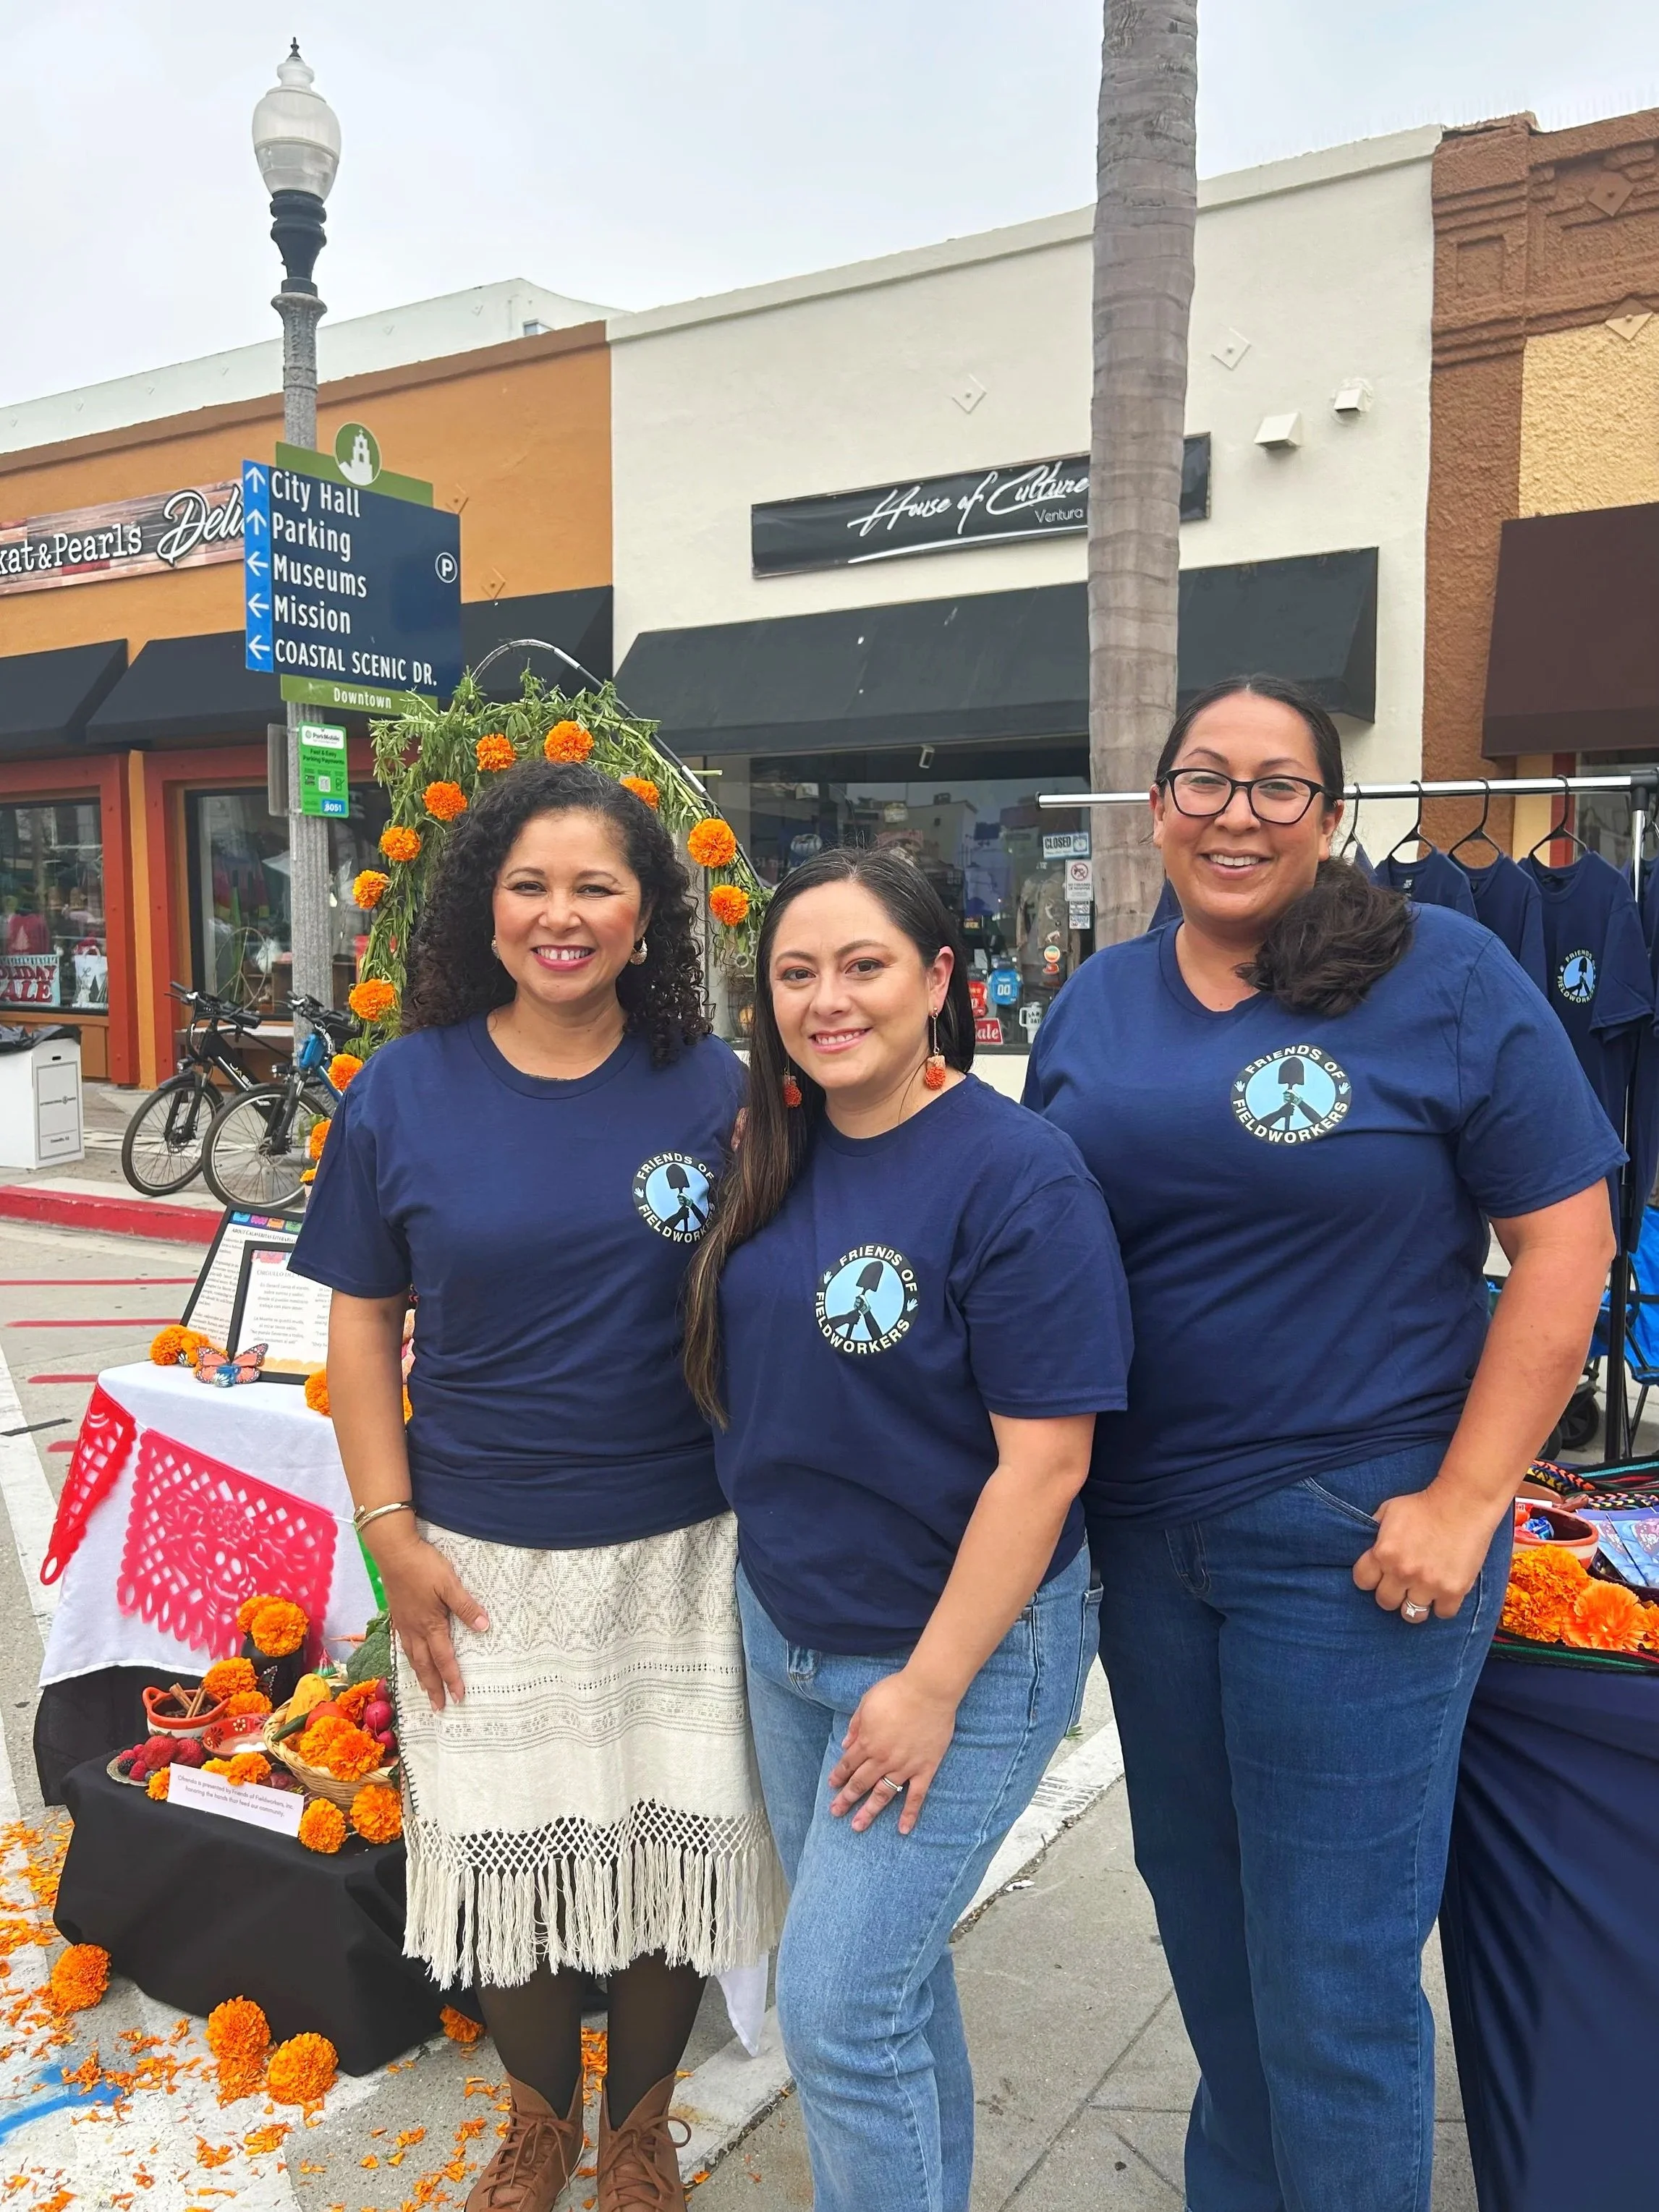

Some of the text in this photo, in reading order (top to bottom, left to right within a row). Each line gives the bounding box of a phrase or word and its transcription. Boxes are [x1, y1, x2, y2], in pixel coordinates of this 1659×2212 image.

[271, 471, 360, 519] City Hall
[847, 461, 1089, 536] House of Culture
[1035, 507, 1084, 524] Ventura
[272, 513, 351, 562] Parking
[273, 553, 366, 598] Museums
[274, 595, 350, 634] Mission
[275, 639, 438, 686] COASTAL SCENIC DR.
[334, 687, 392, 710] Downtown
[1045, 835, 1071, 849] CLOSED
[1565, 949, 1592, 963] FRIENDS
[997, 984, 1011, 995] 00
[975, 1024, 1000, 1039] ale
[1244, 1045, 1346, 1079] FRIENDS OF
[1233, 1099, 1348, 1144] FIELDWORKERS
[637, 1152, 714, 1180] FRIENDS OF
[839, 1245, 918, 1292] FRIENDS OF
[815, 1291, 910, 1354] FIELDWORKERS
[185, 1785, 205, 1797] honoring
[213, 1792, 228, 1801] hands
[229, 1795, 239, 1804] that
[239, 1798, 250, 1807] feed
[202, 1782, 225, 1792] presented
[232, 1788, 248, 1798] Friends
